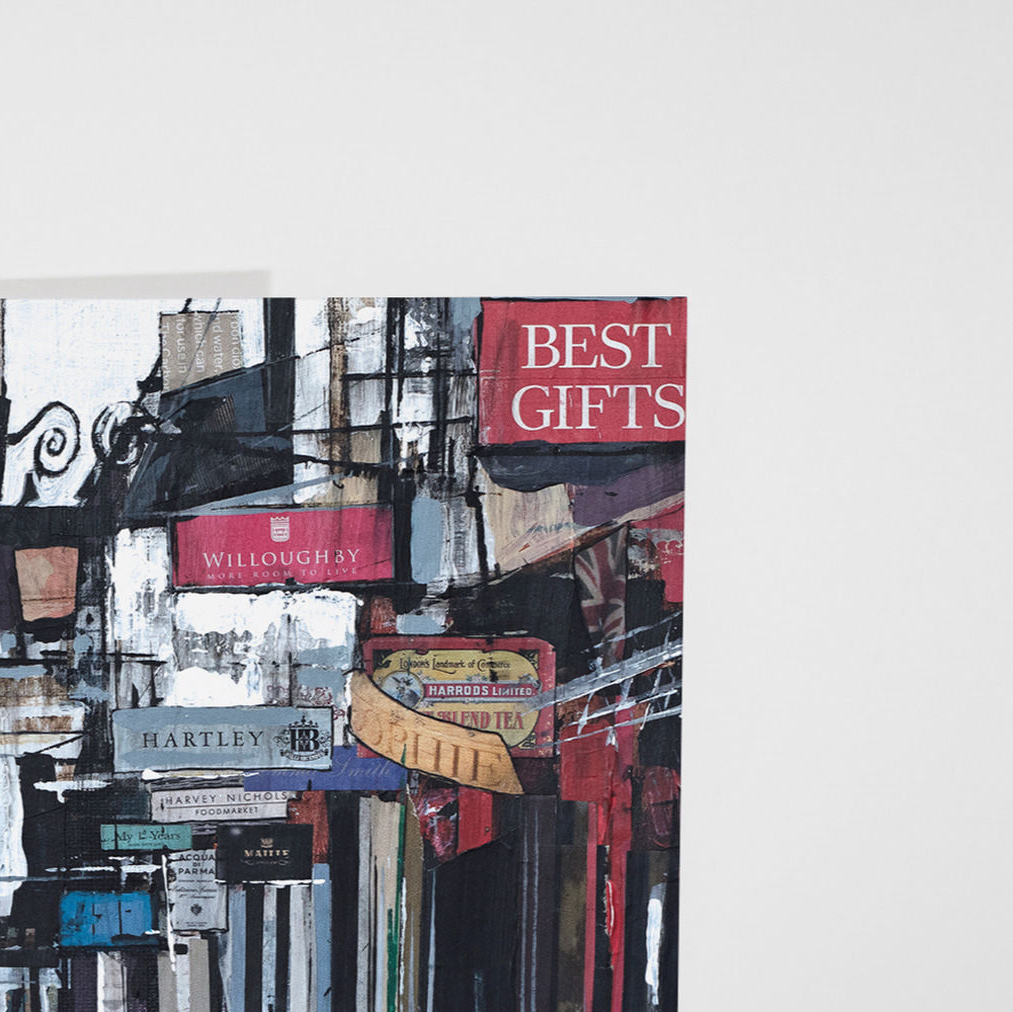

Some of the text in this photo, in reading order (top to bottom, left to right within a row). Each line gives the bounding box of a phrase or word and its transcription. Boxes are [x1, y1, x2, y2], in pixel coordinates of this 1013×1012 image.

[176, 338, 186, 359] use
[521, 323, 672, 369] BEST
[511, 383, 685, 431] GIFTS
[203, 549, 360, 568] WILLOUGHBY
[207, 567, 357, 580] MORE ROOM TO LIVE
[429, 685, 489, 696] HARRODS
[493, 711, 524, 730] TEA
[142, 731, 263, 748] HARTLEY
[165, 791, 288, 805] HARVEY NICHOLS
[195, 806, 259, 816] FOODMARKET
[150, 830, 181, 841] Years
